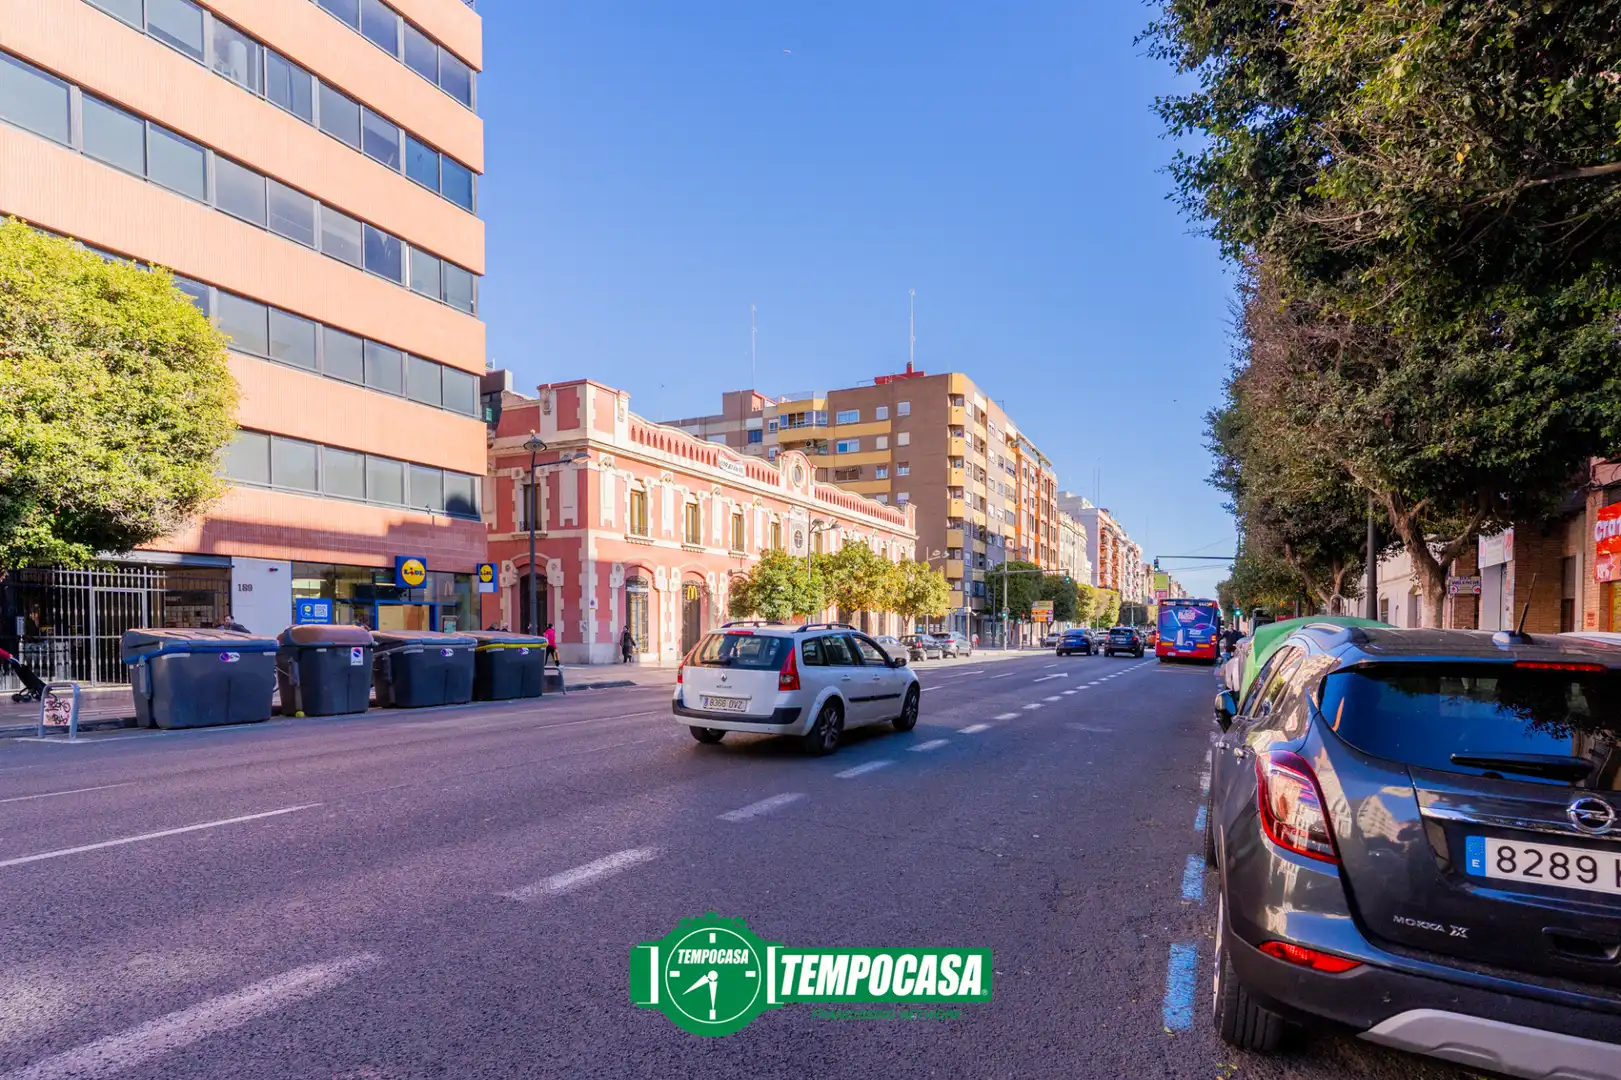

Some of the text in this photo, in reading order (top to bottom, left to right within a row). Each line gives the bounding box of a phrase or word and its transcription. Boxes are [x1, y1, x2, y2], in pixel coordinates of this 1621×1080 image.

[237, 583, 253, 592] 189
[1472, 859, 1480, 867] E
[1496, 845, 1599, 884] 8289
[1393, 915, 1468, 939] MOKKA X
